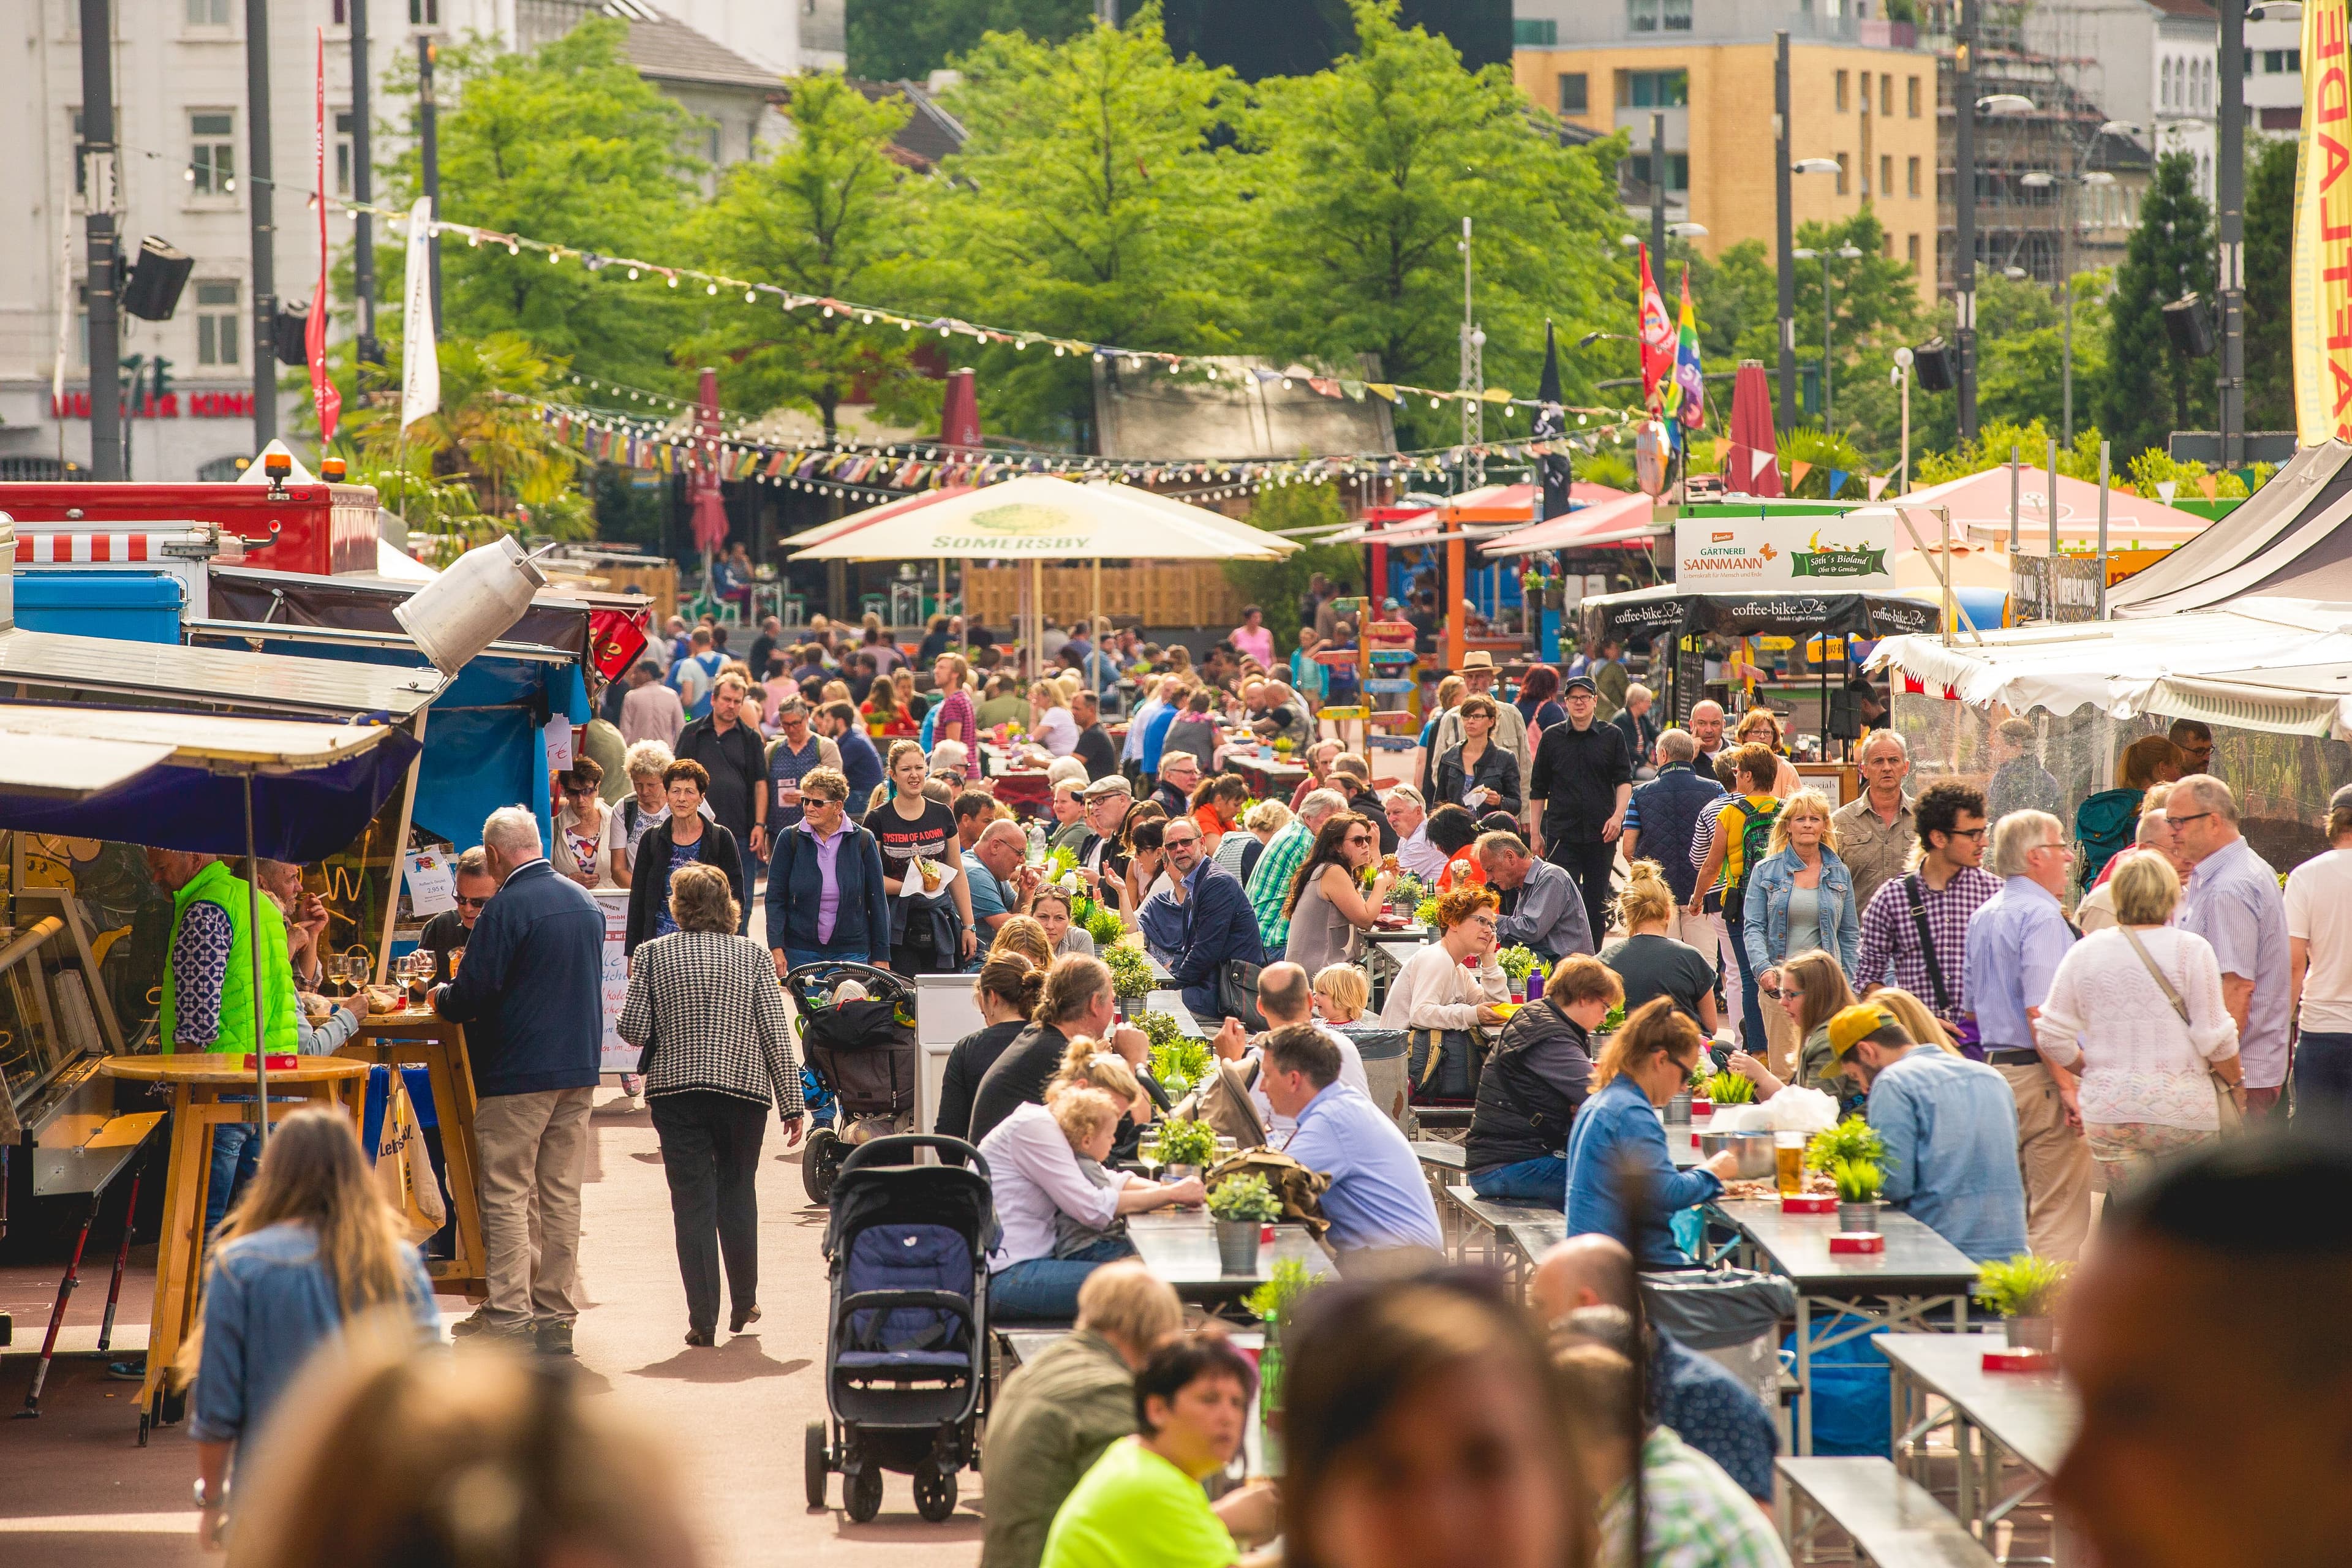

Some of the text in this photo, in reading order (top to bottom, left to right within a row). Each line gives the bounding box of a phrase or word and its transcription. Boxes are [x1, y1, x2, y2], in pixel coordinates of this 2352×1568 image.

[932, 535, 1091, 549] SOMERSBY
[1700, 547, 1746, 556] GÄRTNEREI
[1684, 557, 1763, 571] SANNMANN
[1837, 554, 1869, 565] Bioland
[1615, 606, 1662, 624] coffee-bike
[1733, 601, 1796, 616] coffee-bike
[1872, 607, 1908, 625] coffee-bike
[883, 827, 944, 843] SYSTEM OF A DOWN
